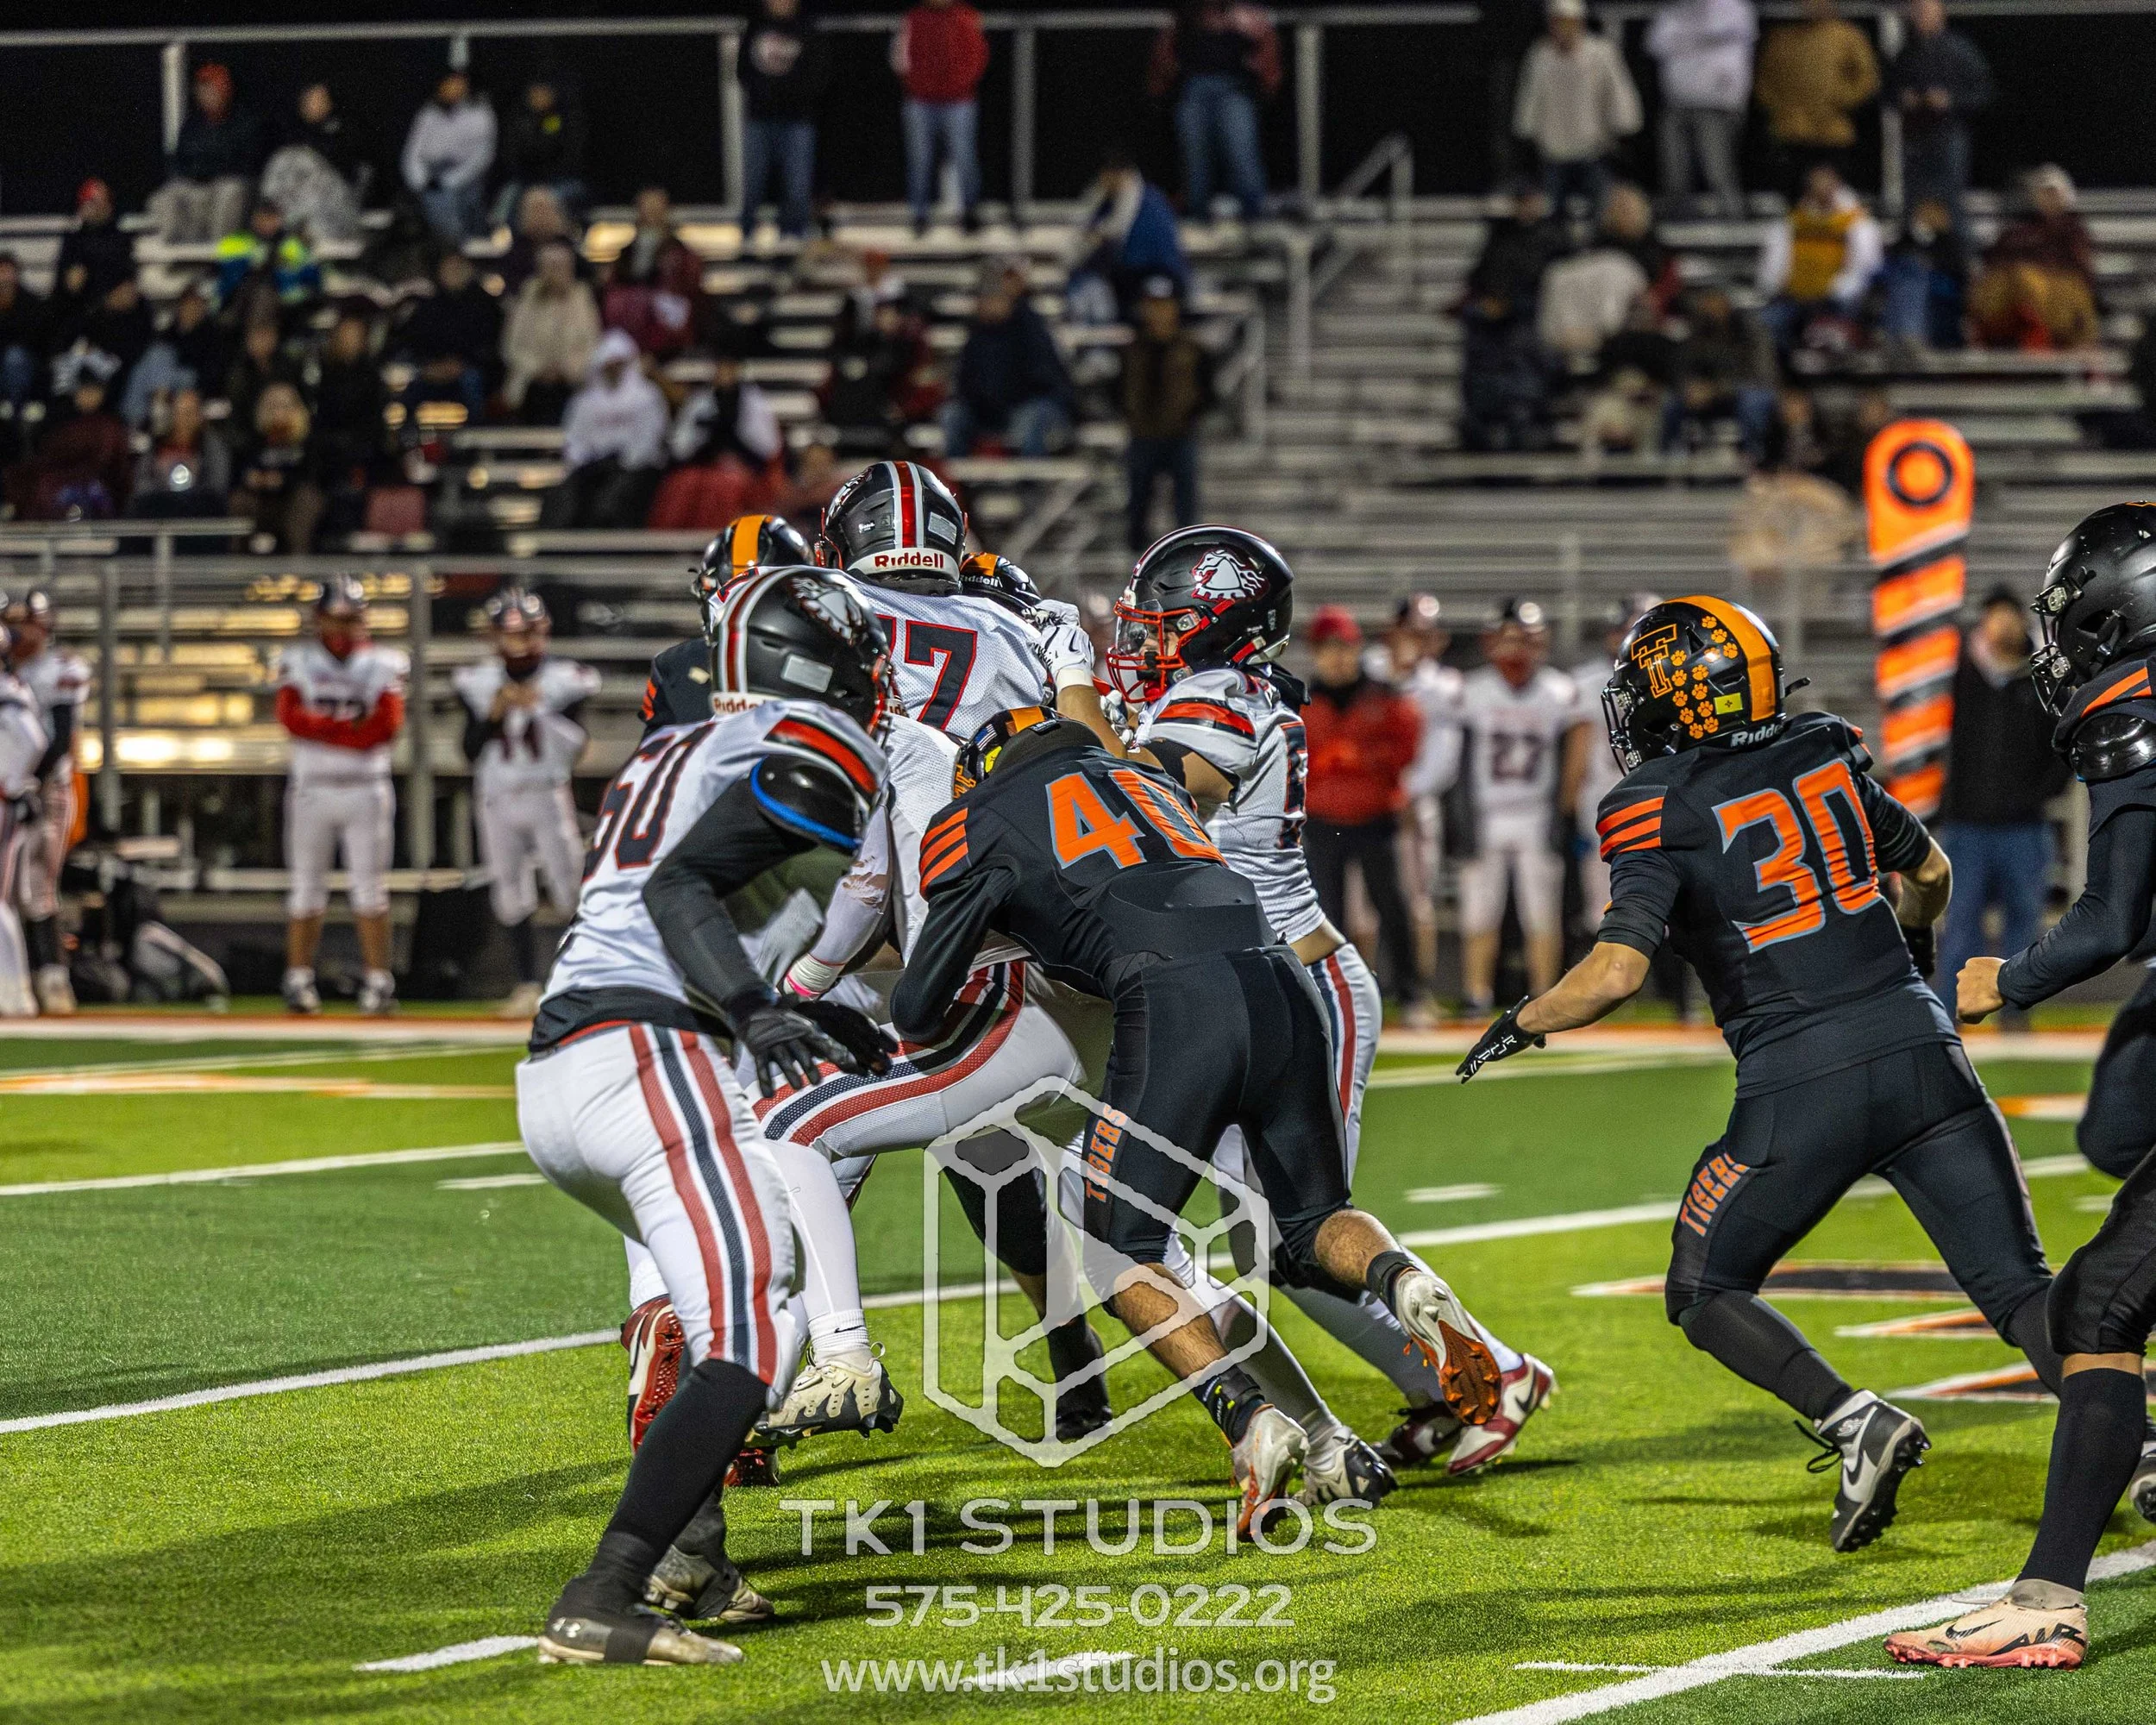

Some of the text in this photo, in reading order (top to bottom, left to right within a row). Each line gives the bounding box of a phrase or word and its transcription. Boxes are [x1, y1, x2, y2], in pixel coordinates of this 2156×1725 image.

[874, 553, 944, 569] Riddell
[874, 613, 978, 731] 7
[1044, 768, 1229, 870] 40
[1711, 757, 1883, 955] 30
[1085, 1103, 1129, 1203] TIGERS
